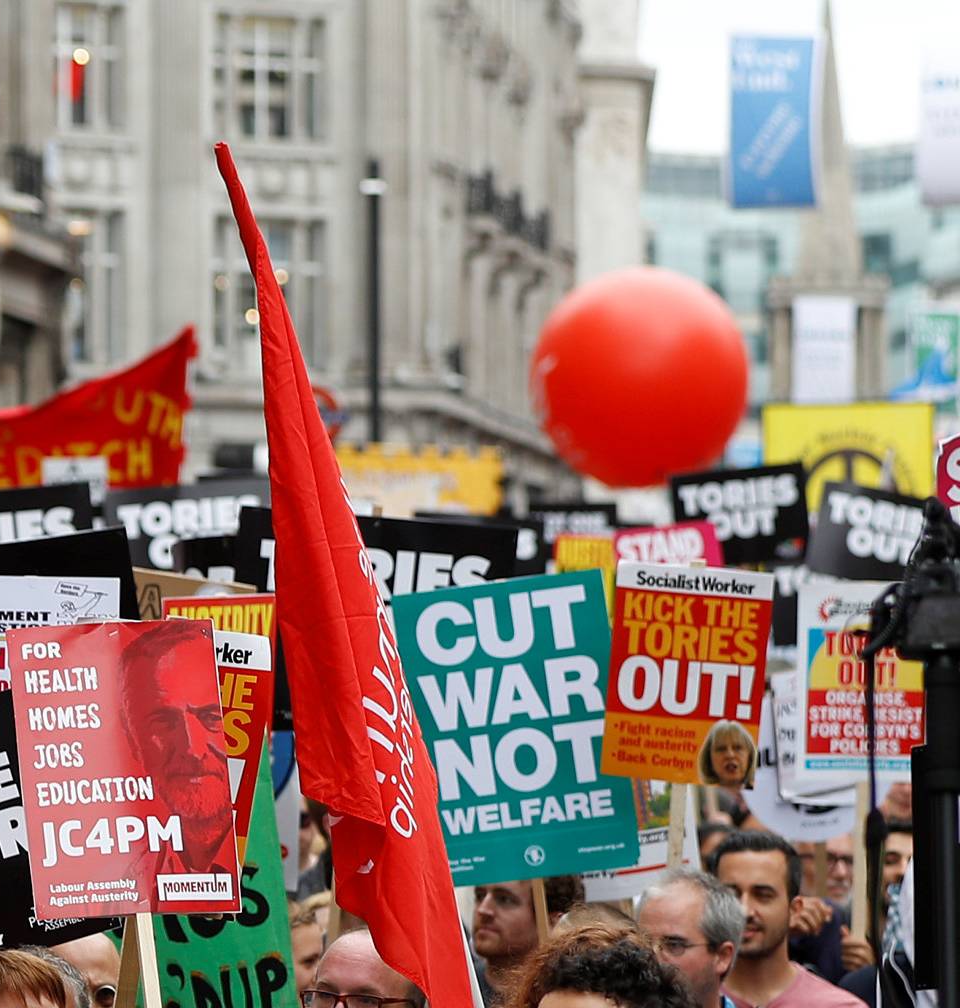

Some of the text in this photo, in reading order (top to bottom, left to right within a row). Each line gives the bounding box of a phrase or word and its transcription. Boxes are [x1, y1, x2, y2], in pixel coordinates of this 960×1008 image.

[678, 473, 799, 516] TORIES
[707, 507, 778, 541] OUT
[617, 528, 704, 562] STAND
[637, 571, 699, 590] Socialist
[702, 577, 755, 594] Worker
[416, 584, 586, 666] CUT
[624, 591, 760, 630] KICK THE
[21, 642, 62, 660] FOR
[623, 620, 757, 664] TORIES
[24, 667, 98, 694] HEALTH
[416, 655, 605, 732] WAR
[617, 655, 756, 719] OUT!
[28, 702, 101, 731] HOMES
[619, 721, 696, 738] Fight racism
[811, 722, 841, 738] FOR
[34, 741, 84, 769] JOBS
[619, 735, 698, 752] and austerity
[433, 719, 605, 801] NOT
[617, 751, 693, 768] Back Corbyn
[36, 776, 153, 807] EDUCATION
[441, 789, 614, 835] WELFARE
[42, 815, 184, 868] JC4PM
[49, 879, 136, 893] Labour Assembly
[49, 891, 139, 906] Against Austerity
[163, 880, 228, 898] MOMENTUM
